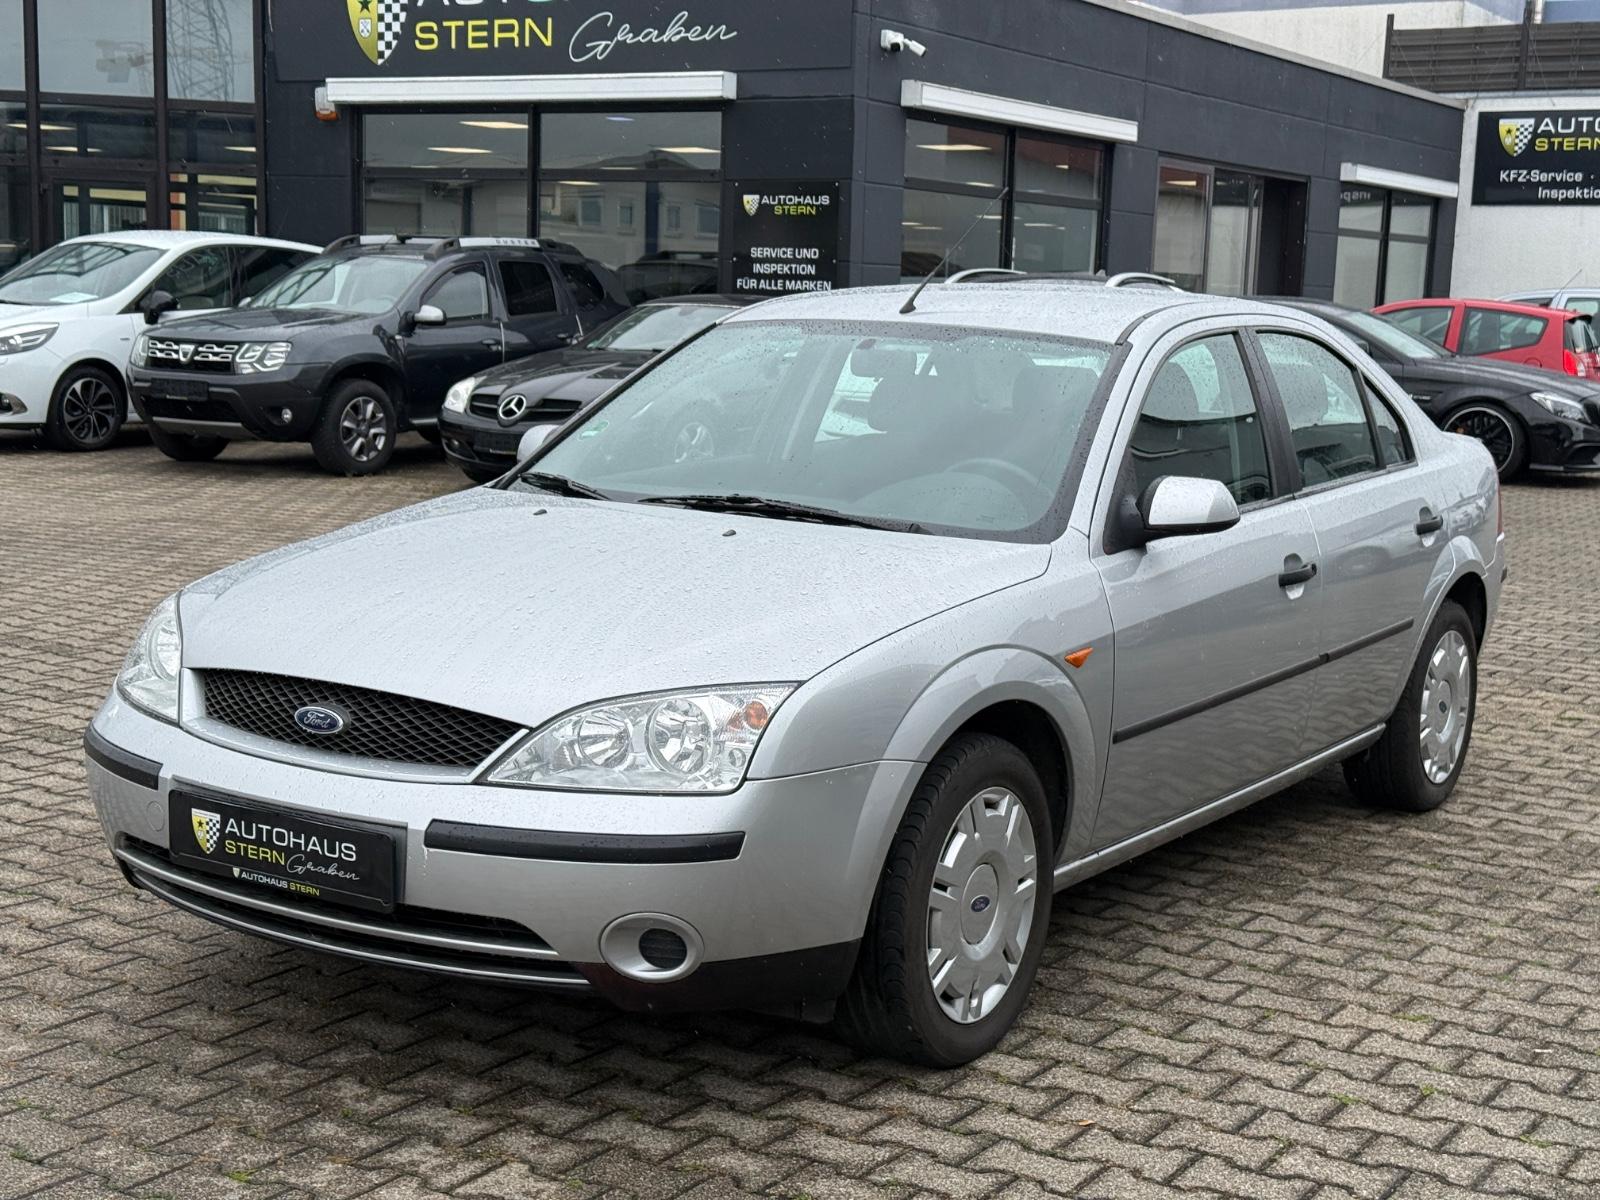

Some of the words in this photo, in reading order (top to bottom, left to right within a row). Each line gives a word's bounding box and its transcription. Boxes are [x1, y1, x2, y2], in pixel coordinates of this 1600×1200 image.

[415, 17, 552, 51] STERN
[568, 11, 737, 62] Graben
[1500, 169, 1583, 182] KFZ-Service
[761, 195, 830, 205] AUTOHAUS
[774, 205, 817, 215] STERN
[750, 247, 794, 258] SERVICE
[795, 248, 819, 259] UND
[753, 263, 816, 275] INSPEKTION
[736, 277, 757, 289] FÜR
[758, 279, 784, 290] ALLE
[785, 280, 832, 292] MARKEN
[303, 711, 331, 729] Ford
[225, 818, 357, 862] AUTOHAUS
[225, 840, 286, 866] STERN
[286, 853, 360, 880] Graben
[241, 871, 288, 888] AUTOHAUS
[289, 882, 320, 896] STERN
